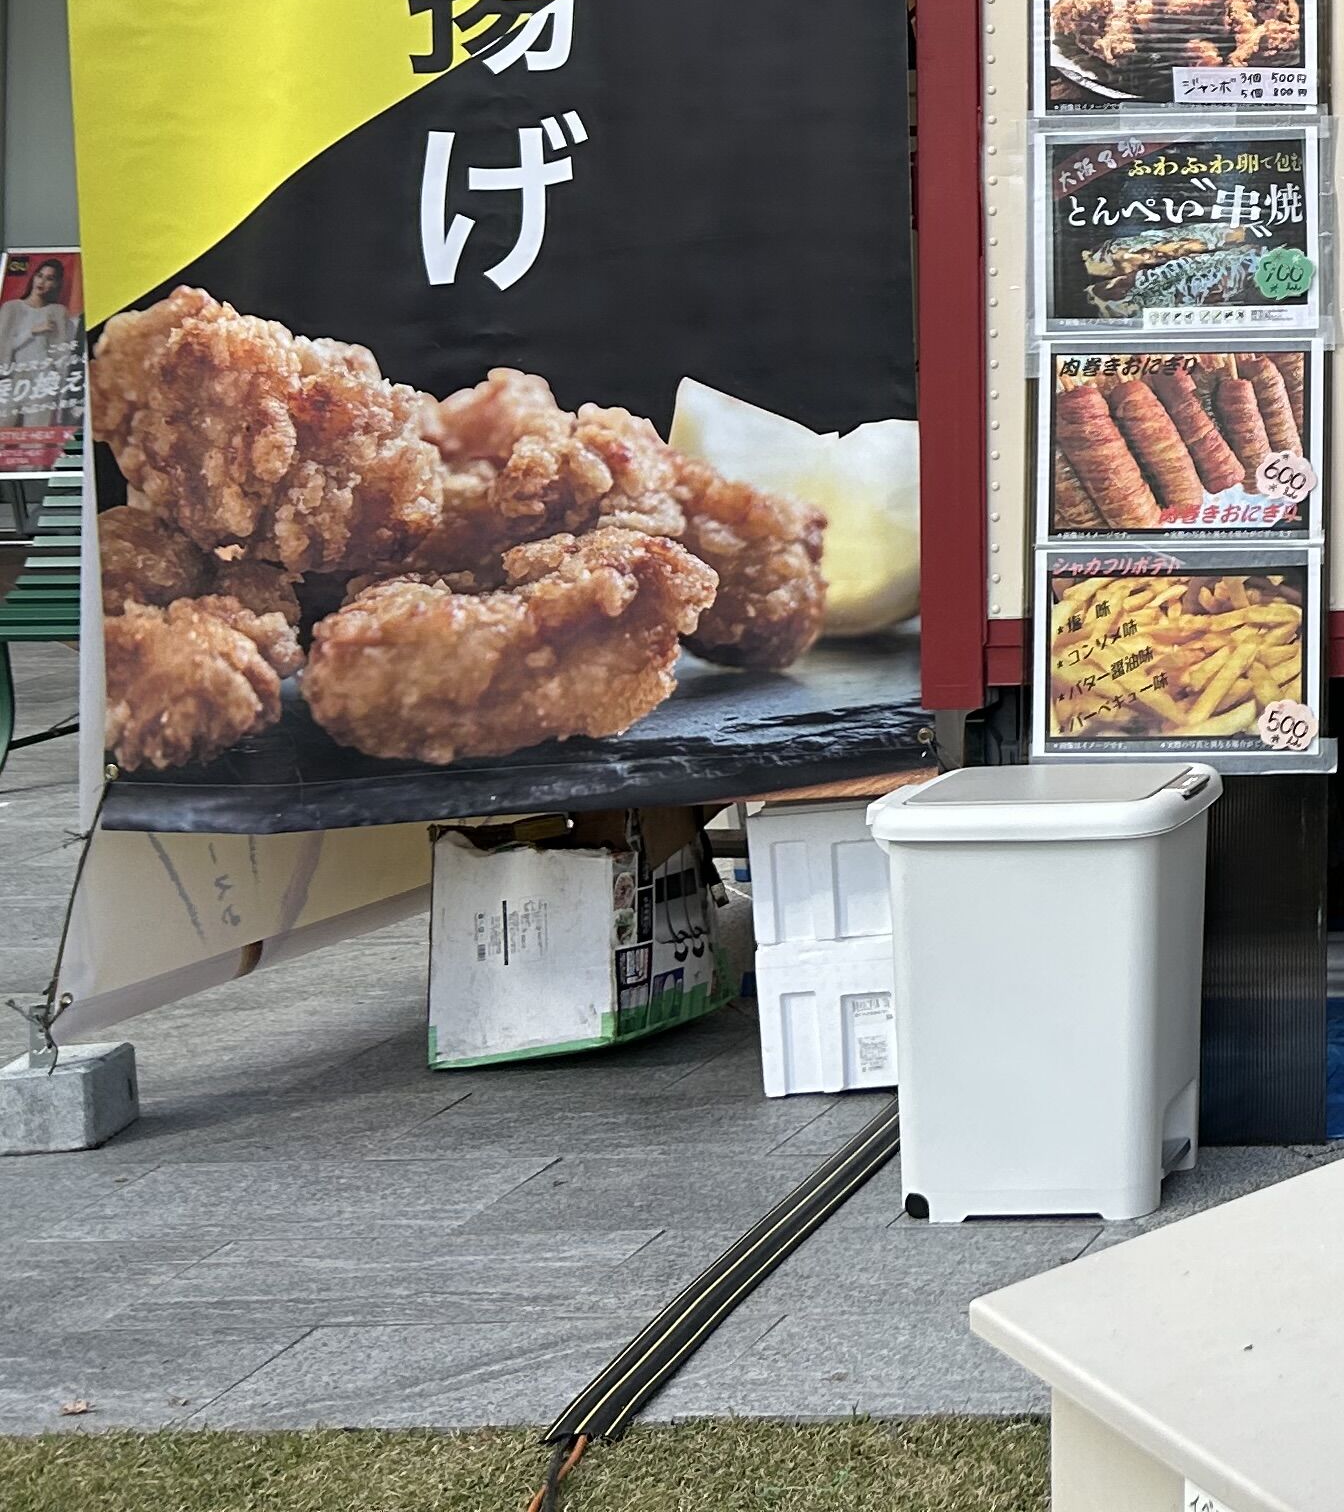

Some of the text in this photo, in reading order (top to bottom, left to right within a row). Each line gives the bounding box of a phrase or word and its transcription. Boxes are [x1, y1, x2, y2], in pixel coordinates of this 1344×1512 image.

[1059, 356, 1198, 378] 肉巻きおにぎり
[1264, 459, 1307, 490] 600
[1067, 618, 1138, 667] コンソメ味
[1069, 672, 1169, 732] バーベキュー味
[1267, 710, 1309, 738] 500
